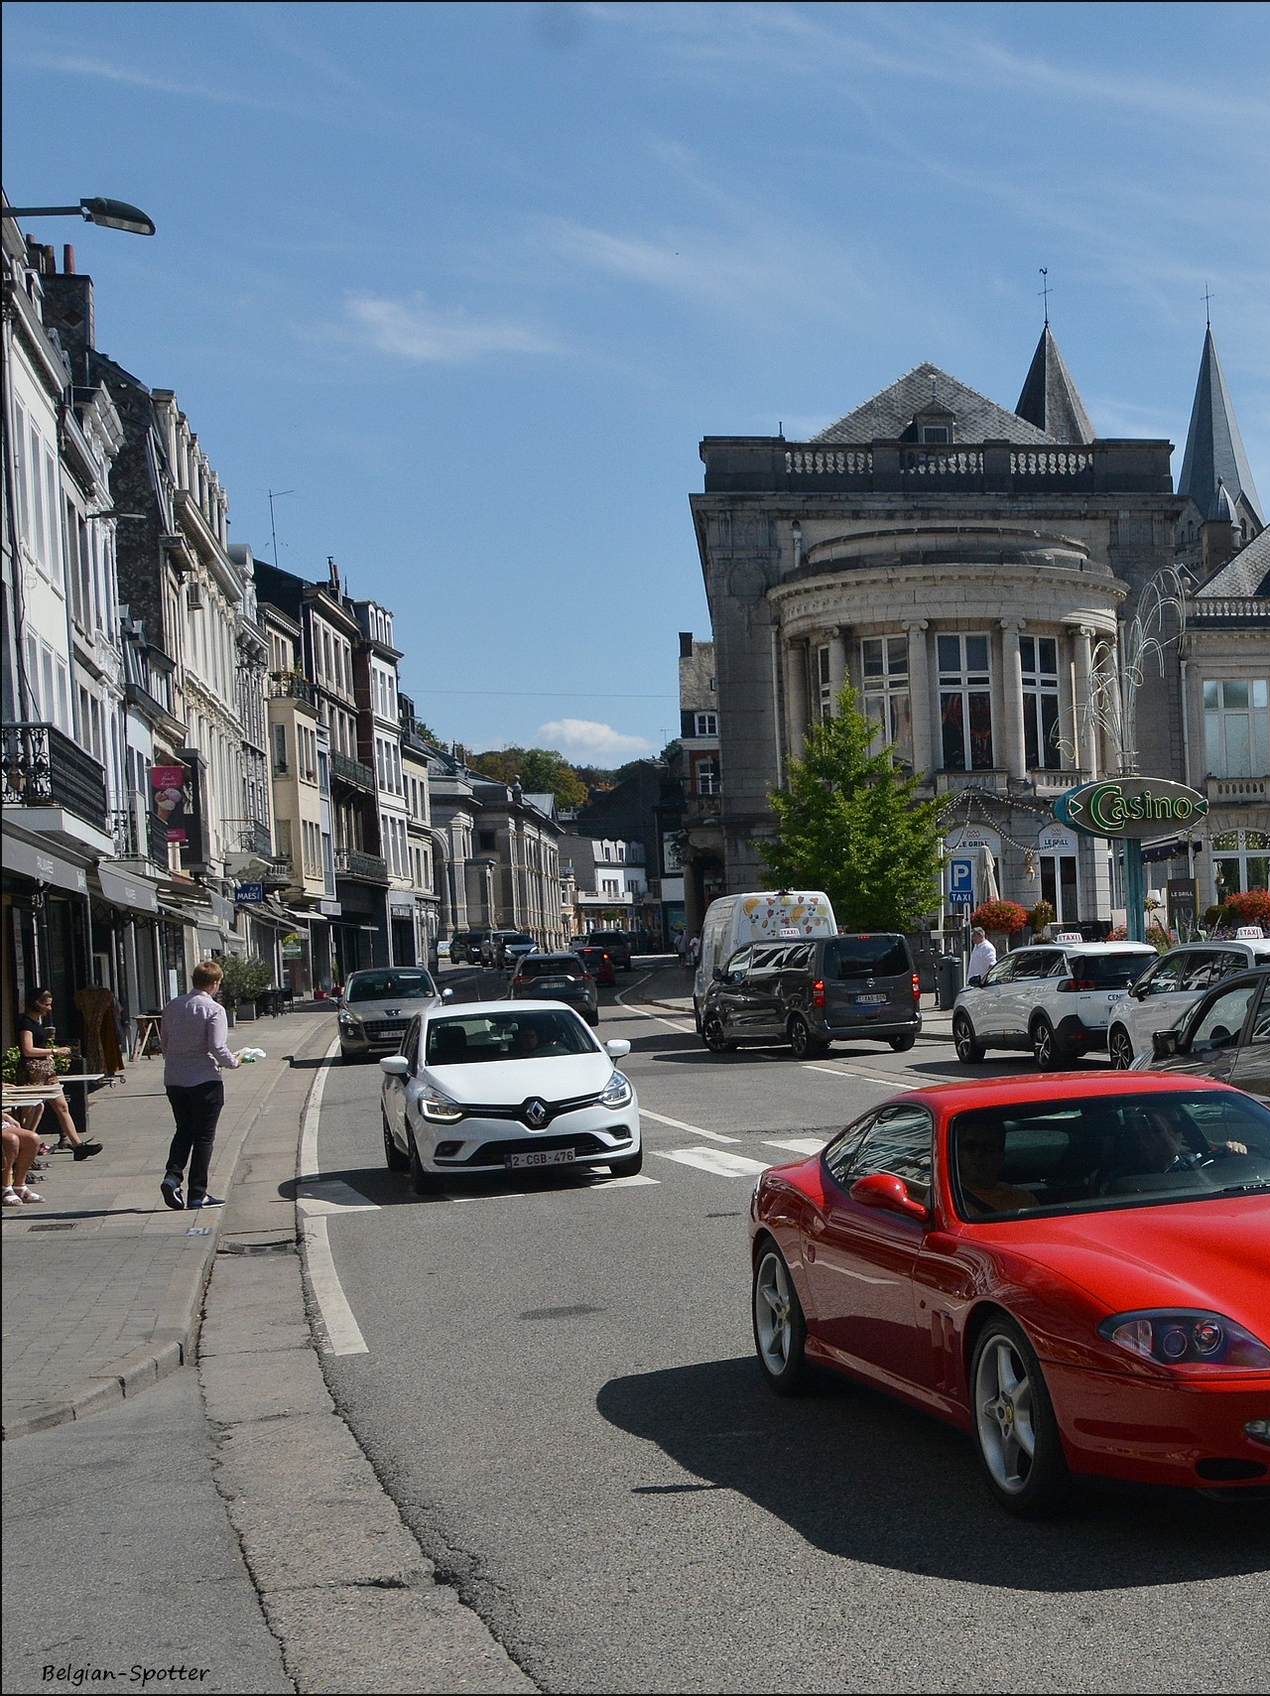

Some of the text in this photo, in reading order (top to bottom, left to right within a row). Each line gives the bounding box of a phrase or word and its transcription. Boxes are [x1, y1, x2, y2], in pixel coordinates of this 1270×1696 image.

[1090, 785, 1193, 831] Casino
[954, 864, 970, 887] P
[237, 892, 257, 900] MAES
[952, 893, 971, 901] TAXI
[1243, 928, 1259, 937] TAXI
[1062, 934, 1080, 942] TAXI
[512, 1151, 574, 1167] 2-CGB-476
